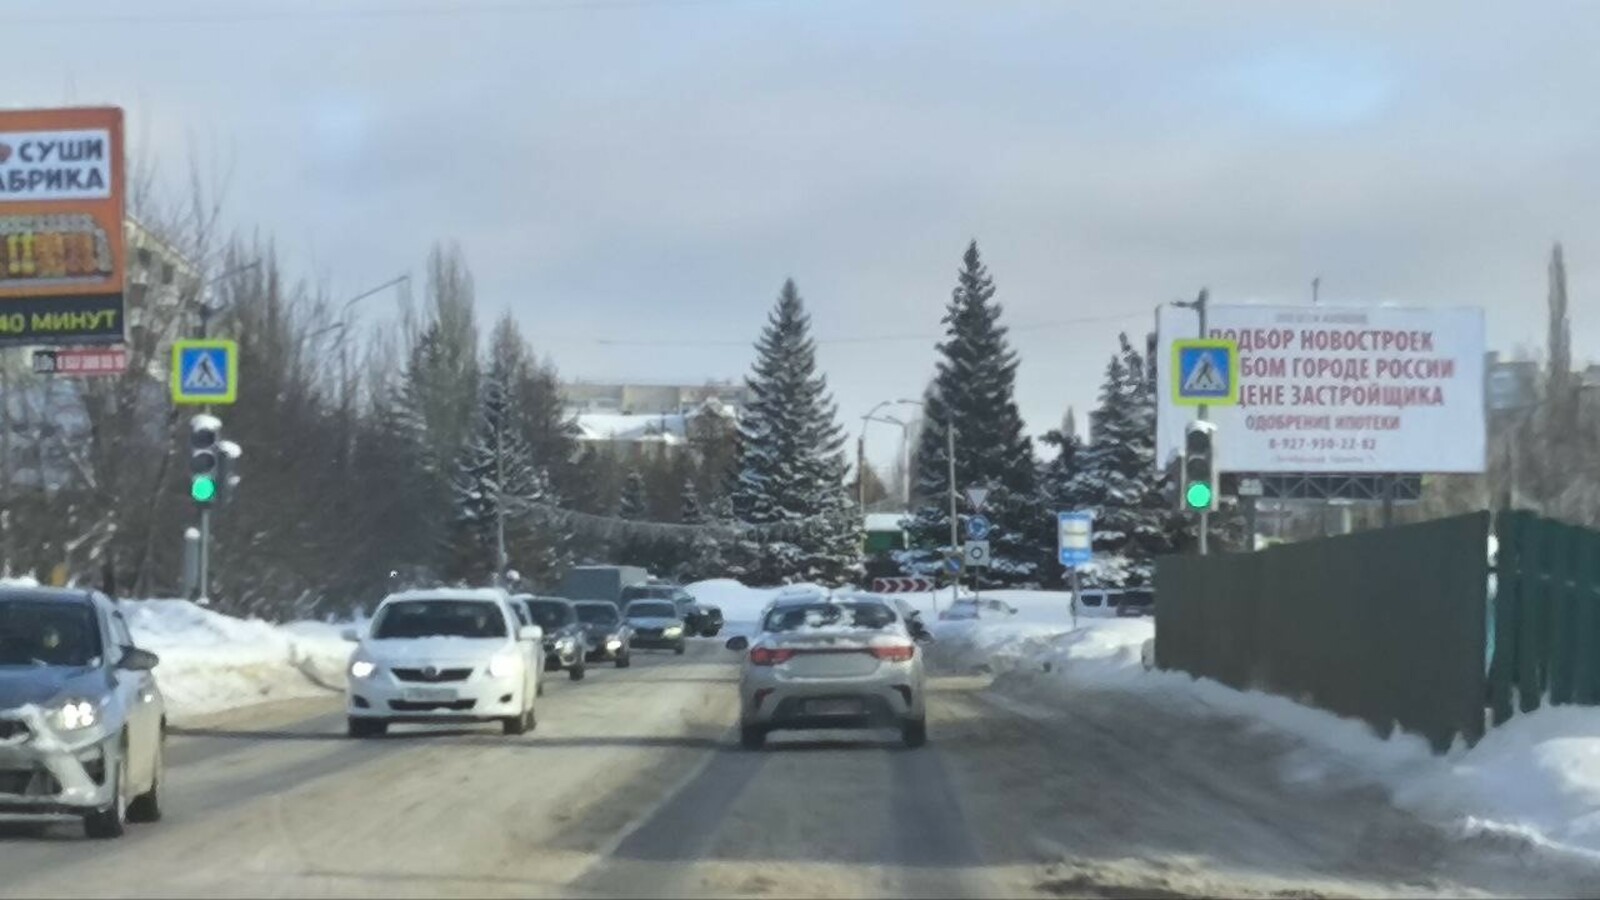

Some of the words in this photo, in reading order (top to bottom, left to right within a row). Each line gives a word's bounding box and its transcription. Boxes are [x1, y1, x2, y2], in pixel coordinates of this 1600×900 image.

[18, 138, 103, 163] СУШИ
[31, 309, 117, 331] МИНУТ
[1300, 329, 1434, 352] НОВОСТРОЕК
[1240, 356, 1286, 378] БОМ
[1292, 358, 1369, 381] ГОРОДЕ
[1375, 358, 1456, 380] РОССИИ
[1291, 383, 1445, 408] ЗАСТРОЙЩИКА
[1245, 414, 1331, 431] ОДОБРЕНИЕ
[1335, 414, 1400, 430] ИПОТЕКИ
